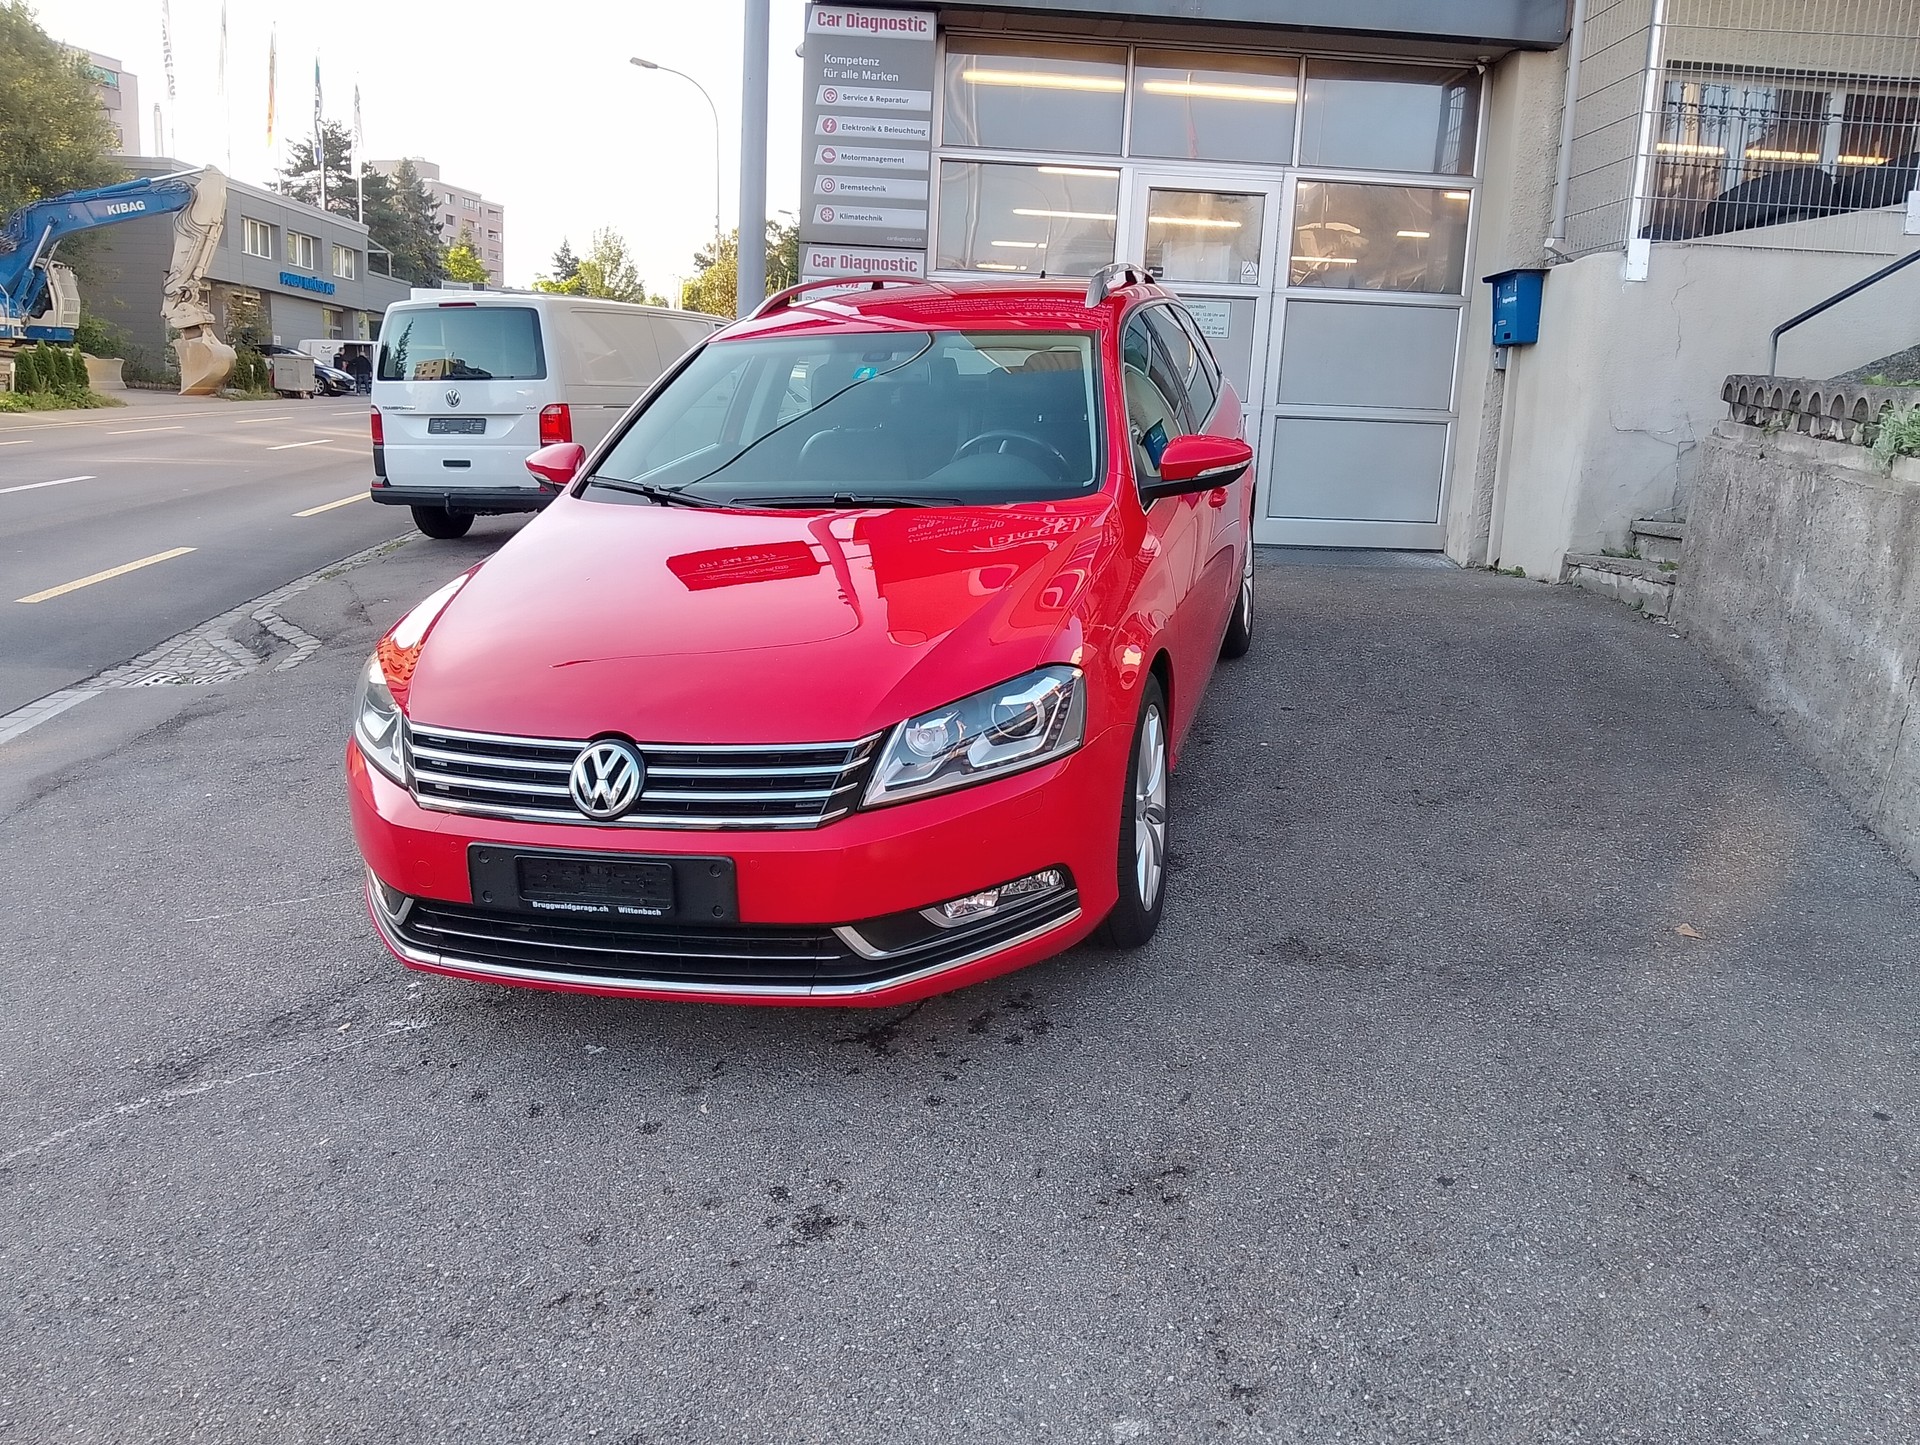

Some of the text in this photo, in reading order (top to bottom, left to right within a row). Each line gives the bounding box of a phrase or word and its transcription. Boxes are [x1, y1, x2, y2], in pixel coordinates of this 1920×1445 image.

[817, 11, 928, 33] Car Diagnostic
[824, 54, 880, 67] Kompetenz
[823, 68, 899, 82] für alle Marken
[842, 93, 909, 105] Service & Reparatur
[841, 123, 926, 136] Elektronik & Beleuchtung
[840, 153, 905, 164] Motormanagement
[840, 183, 887, 193] Bremstechnik
[107, 200, 146, 215] KIBAG
[839, 212, 883, 222] Klimatechnik
[812, 253, 918, 274] Car Diagnostic
[570, 741, 646, 819] VW
[532, 901, 662, 916] Bruggwaldgarage.ch Wittenbach
